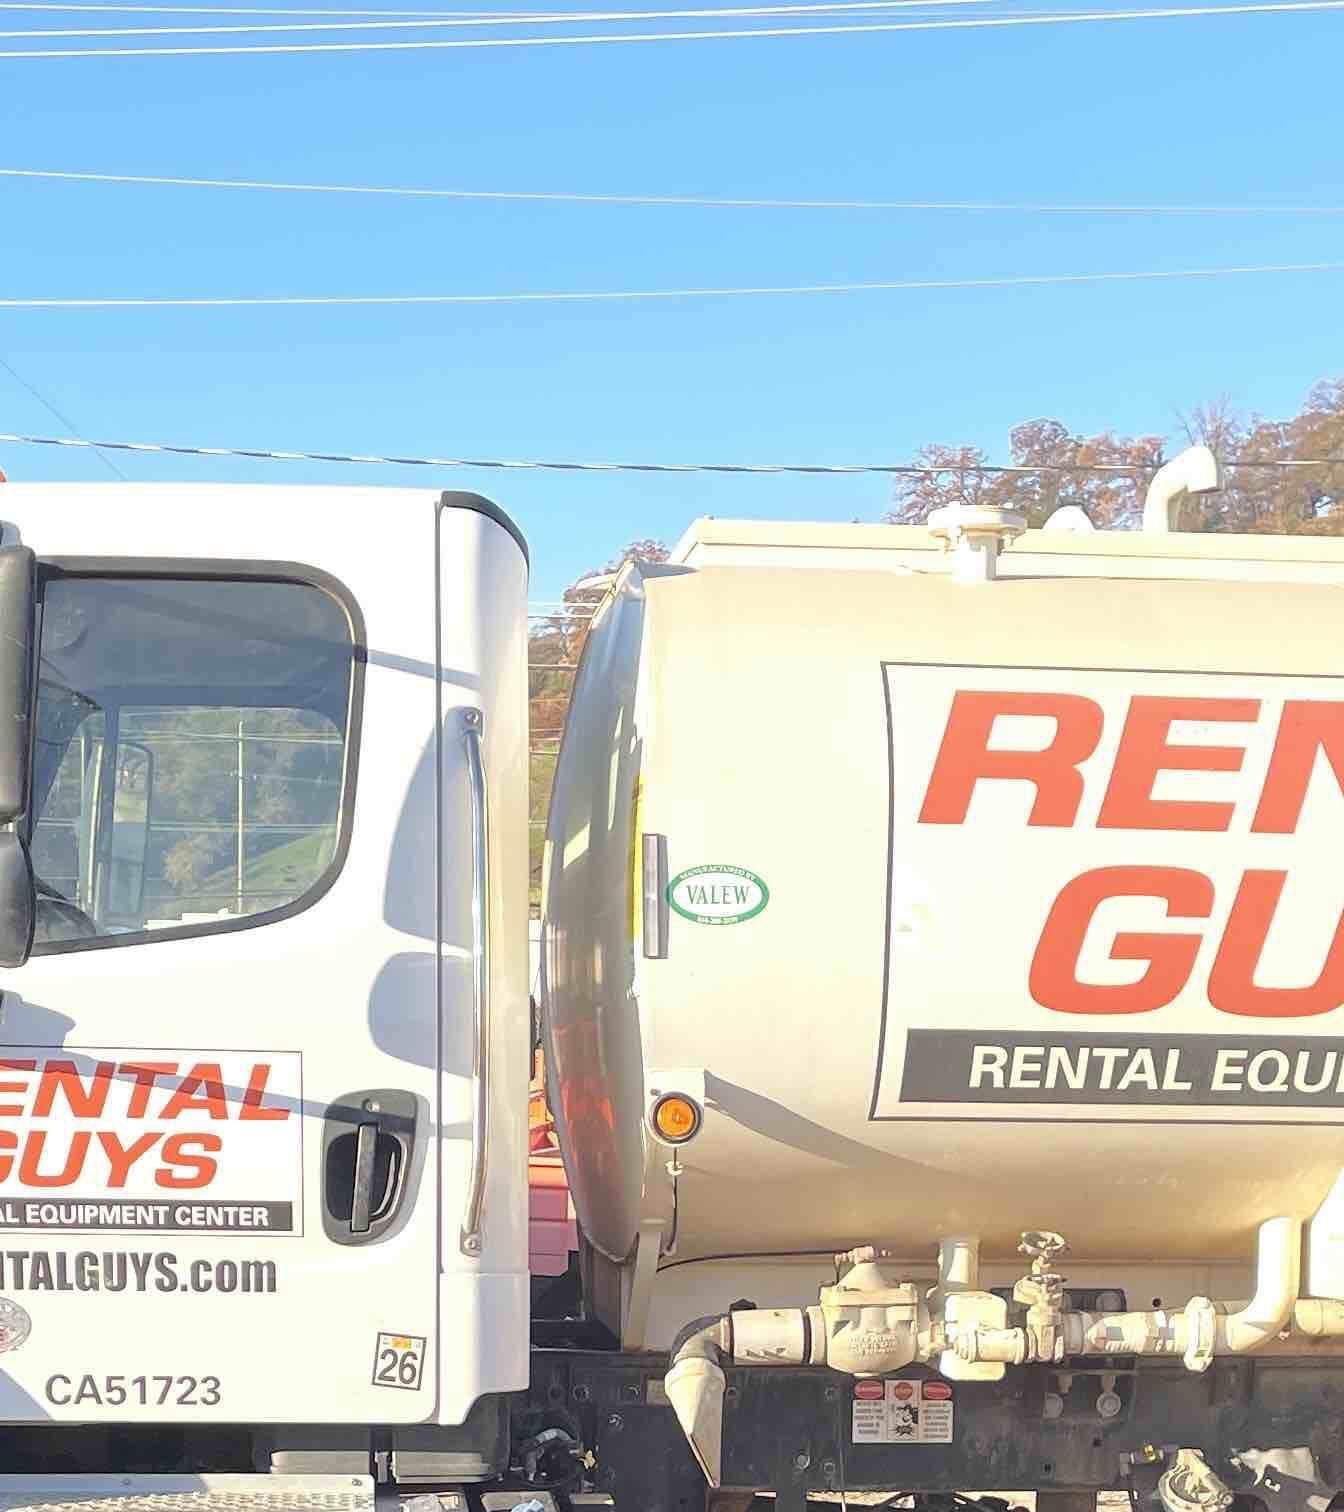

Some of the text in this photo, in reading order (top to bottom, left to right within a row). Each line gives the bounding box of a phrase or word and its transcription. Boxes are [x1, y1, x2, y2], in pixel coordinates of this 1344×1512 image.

[686, 885, 751, 905] VALEW
[967, 1045, 1192, 1091] RENTAL
[25, 1203, 170, 1226] EQUIPMENT
[174, 1205, 270, 1227] CENTER
[377, 1349, 418, 1385] 26
[45, 1373, 221, 1406] CA51723
